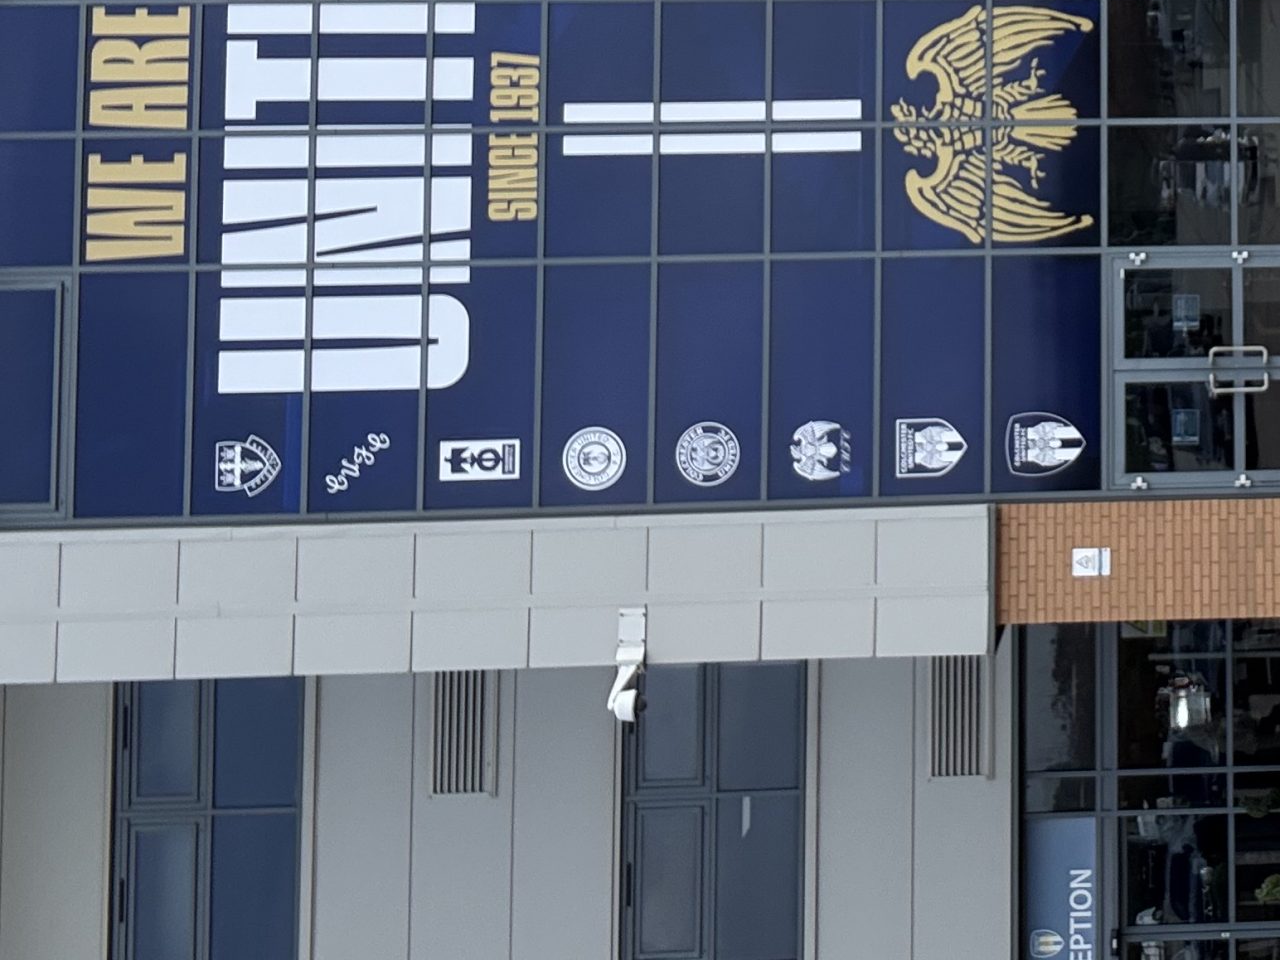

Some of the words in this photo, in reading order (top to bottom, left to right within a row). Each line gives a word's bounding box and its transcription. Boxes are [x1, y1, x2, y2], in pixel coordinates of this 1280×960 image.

[89, 5, 190, 129] ARE
[489, 52, 540, 123] 1937
[86, 152, 186, 262] WE
[488, 132, 538, 221] SINCE
[679, 426, 703, 481] COLCHESTER
[900, 423, 908, 473] COLCHESTER
